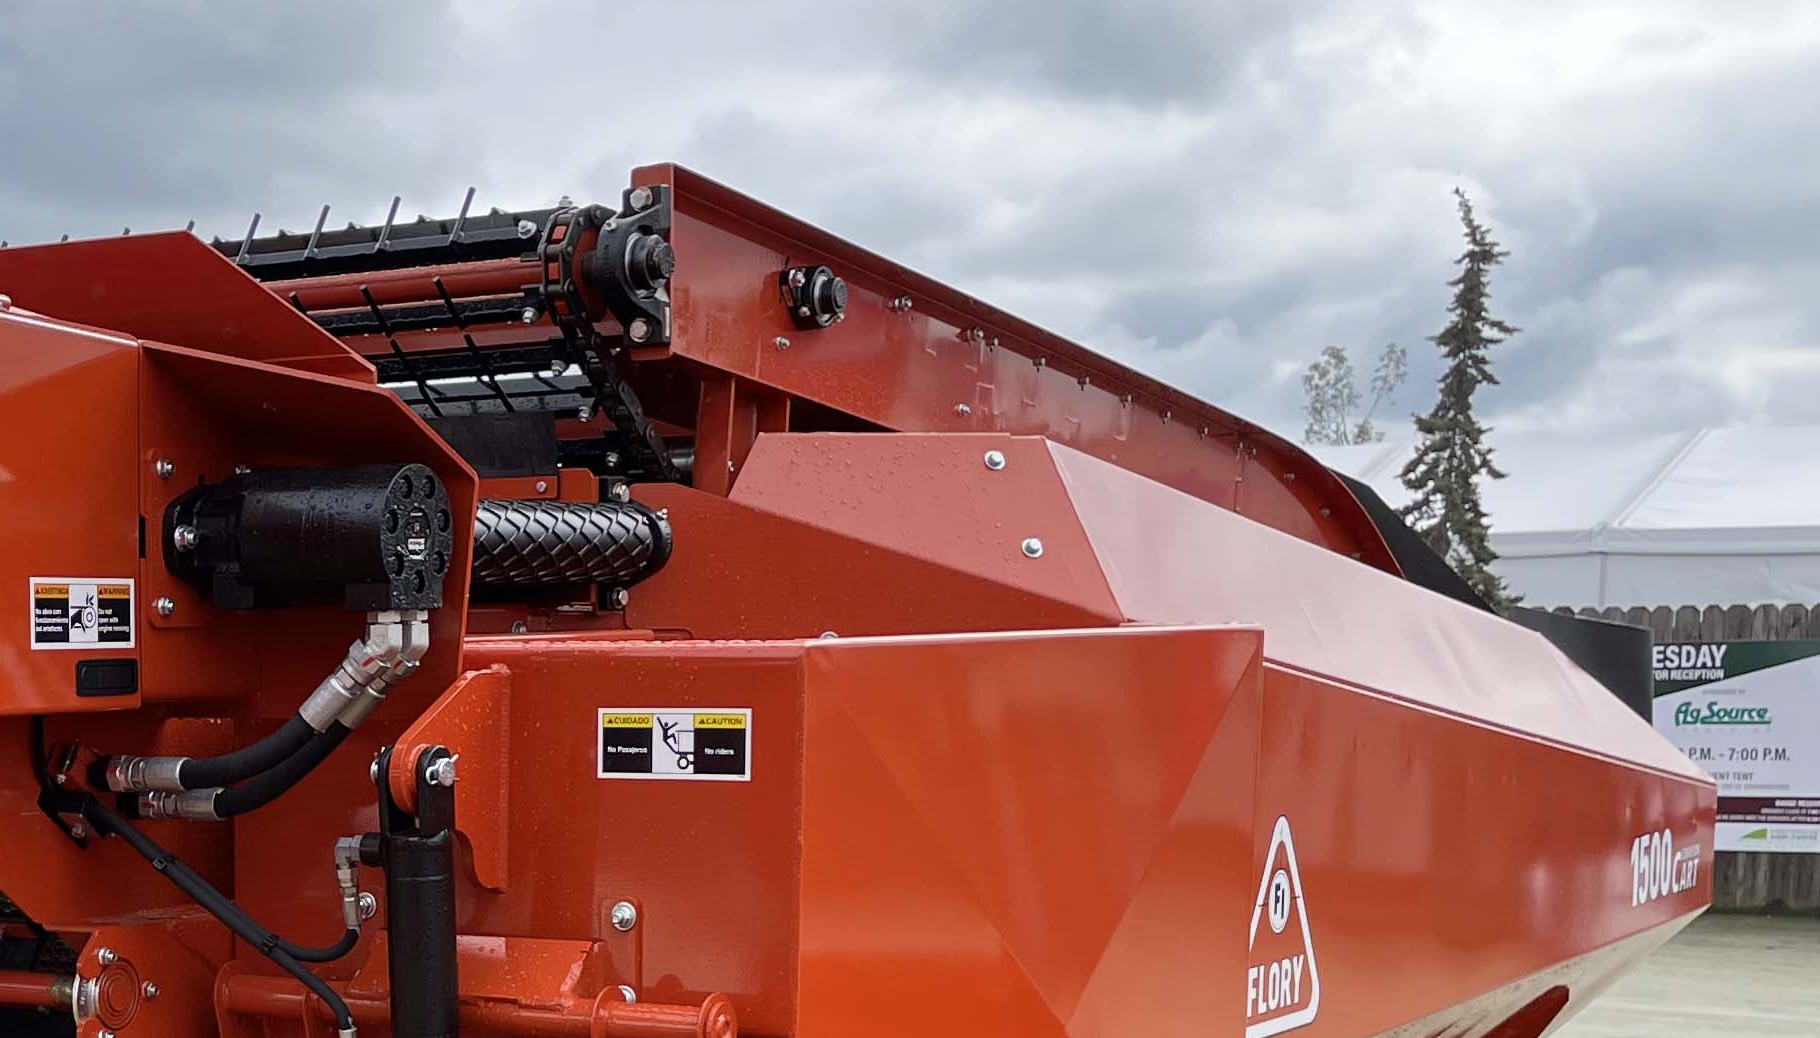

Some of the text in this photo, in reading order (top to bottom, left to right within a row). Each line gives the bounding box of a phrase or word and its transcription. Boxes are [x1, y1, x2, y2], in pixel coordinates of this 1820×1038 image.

[1652, 644, 1727, 669] ESDAY
[1652, 669, 1725, 681] OR RECEPTION
[614, 716, 650, 725] CUIDADO
[706, 717, 743, 726] CAUTION
[1688, 747, 1716, 761] P.M.
[1728, 747, 1759, 761] 7:00
[1762, 747, 1791, 761] P.M.
[1733, 772, 1754, 781] TENT
[1630, 828, 1700, 908] 1500 CART
[1246, 954, 1305, 1018] FLORY
